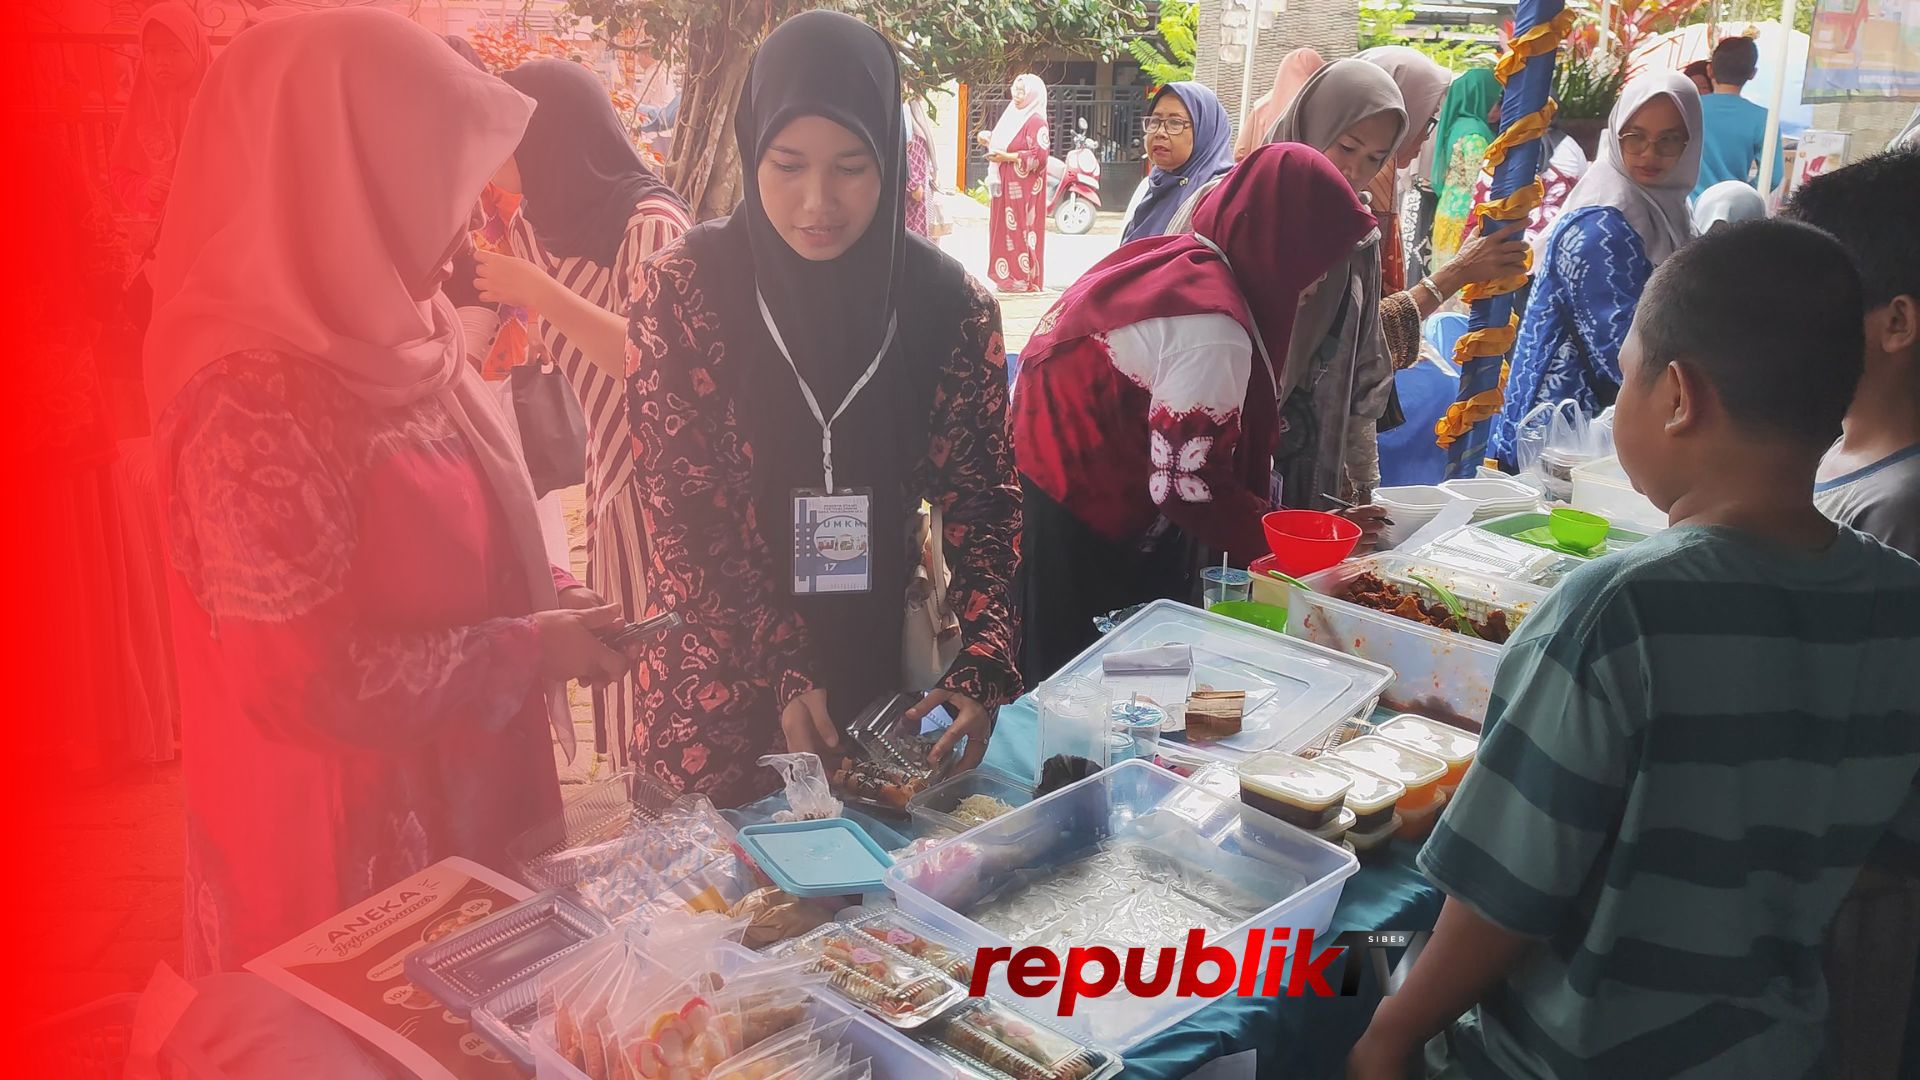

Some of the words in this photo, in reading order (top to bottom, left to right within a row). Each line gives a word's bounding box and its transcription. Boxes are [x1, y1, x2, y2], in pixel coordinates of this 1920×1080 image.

[823, 520, 863, 528] UMKM
[824, 562, 838, 572] 17
[327, 891, 421, 944] ANEKA
